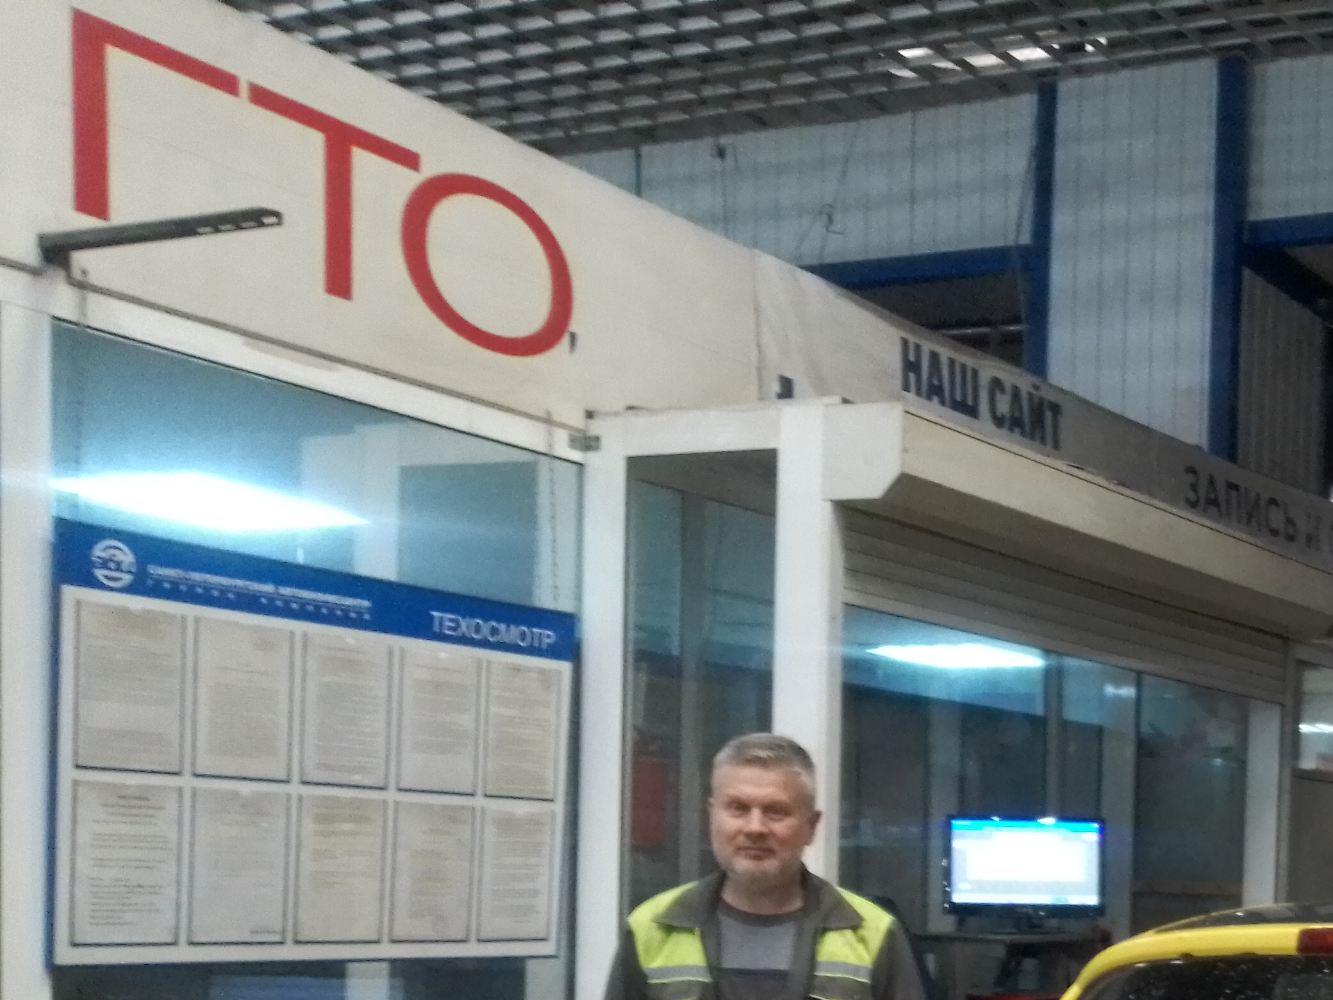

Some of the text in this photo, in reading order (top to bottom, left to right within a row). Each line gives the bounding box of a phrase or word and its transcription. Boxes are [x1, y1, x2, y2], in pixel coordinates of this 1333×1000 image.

[72, 8, 574, 357] ГТО
[900, 335, 1063, 451] НАШ САЙТ
[1184, 465, 1298, 544] ЗАПИСЬ
[429, 610, 557, 650] ТЕХОСМОТР
